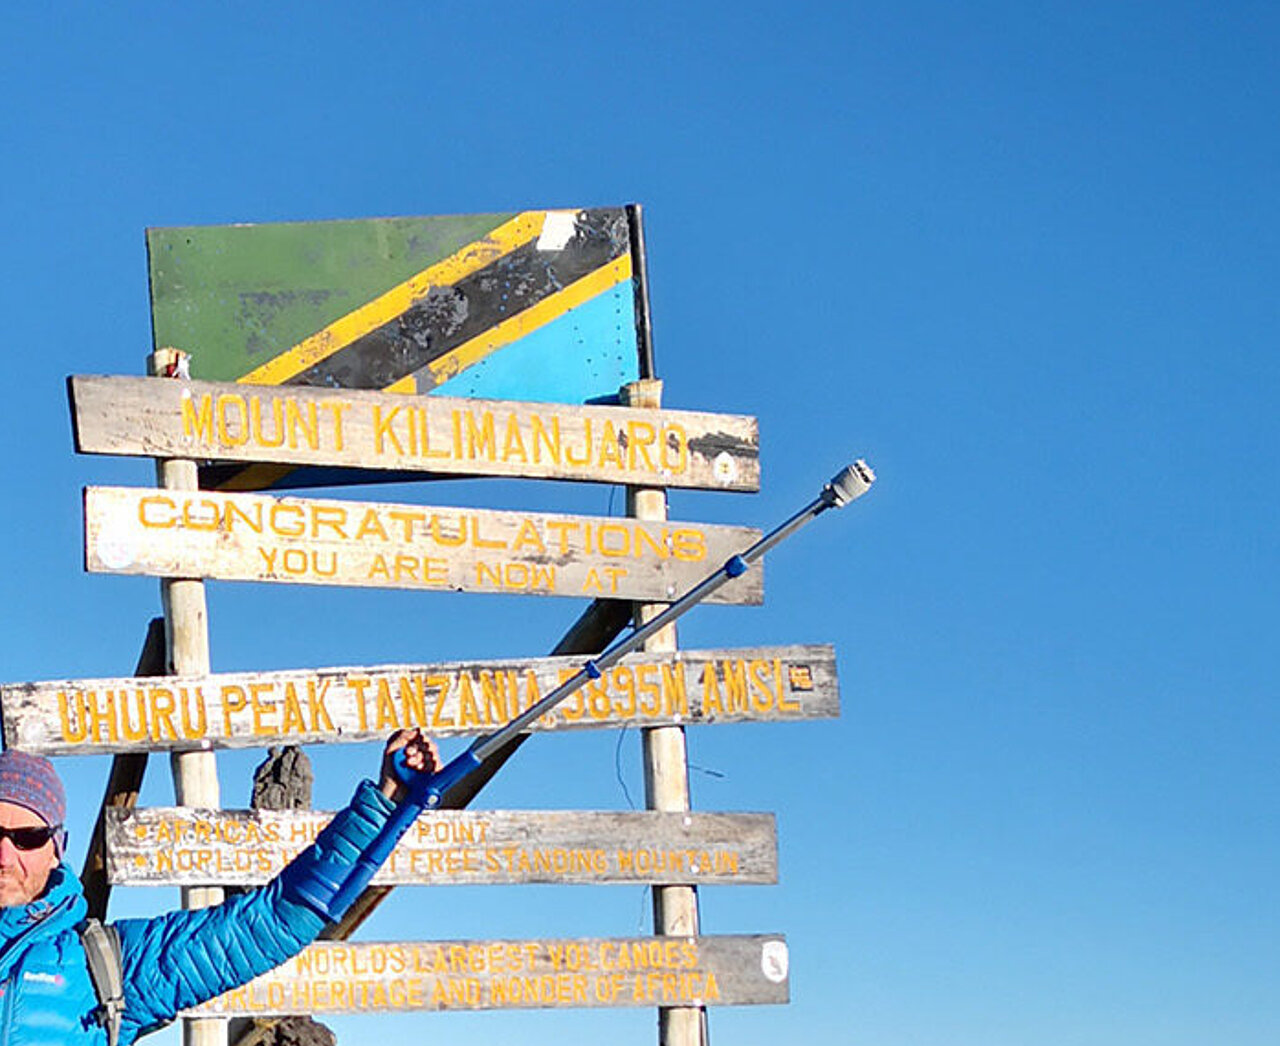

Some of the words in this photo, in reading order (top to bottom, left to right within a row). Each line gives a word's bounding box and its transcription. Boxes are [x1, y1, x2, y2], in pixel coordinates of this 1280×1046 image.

[182, 394, 351, 452] MOUNT
[373, 404, 688, 475] KILIMANJARO
[138, 495, 708, 562] CONGRATULATIONS
[259, 546, 338, 577] YOU
[368, 554, 448, 584] ARE
[477, 560, 556, 590] NOW
[583, 568, 627, 593] AT
[57, 685, 208, 743] UHURU
[558, 661, 688, 719] 5895M
[702, 657, 801, 714] AMSL
[417, 822, 490, 844] POINT
[410, 850, 479, 873] FREE
[486, 849, 608, 873] STANDING
[617, 849, 739, 875] MOUNTAIN
[413, 944, 538, 974] LARGEST
[548, 941, 698, 971] VOLCANOES
[291, 979, 423, 1009] HERITAGE
[431, 977, 482, 1006] AND
[491, 974, 589, 1003] WONDER
[596, 974, 624, 1001] OF
[632, 971, 720, 1001] AFRICA
